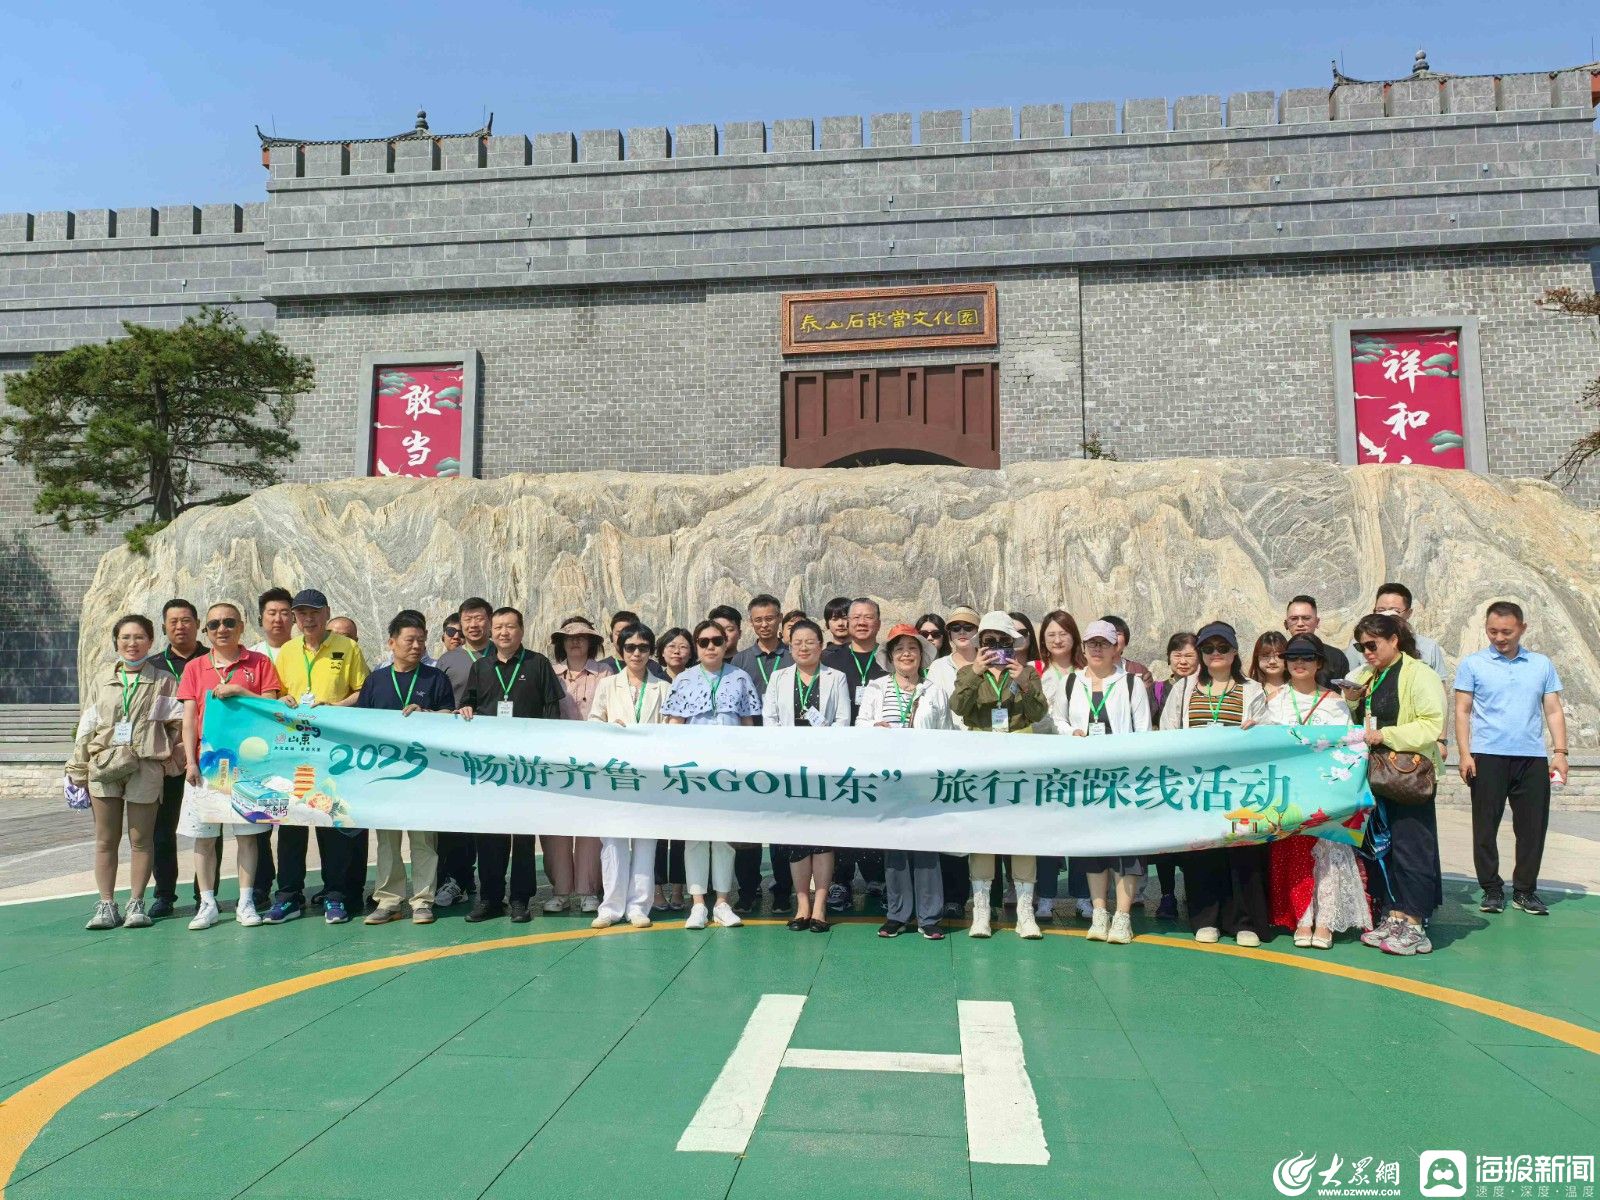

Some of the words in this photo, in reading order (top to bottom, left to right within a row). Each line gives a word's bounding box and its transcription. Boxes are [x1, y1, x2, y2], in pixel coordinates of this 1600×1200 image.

[400, 383, 441, 478] 敢当
[1382, 349, 1431, 464] 祥和
[327, 741, 429, 784] 2025
[929, 762, 1291, 814] 旅行商踩线活动
